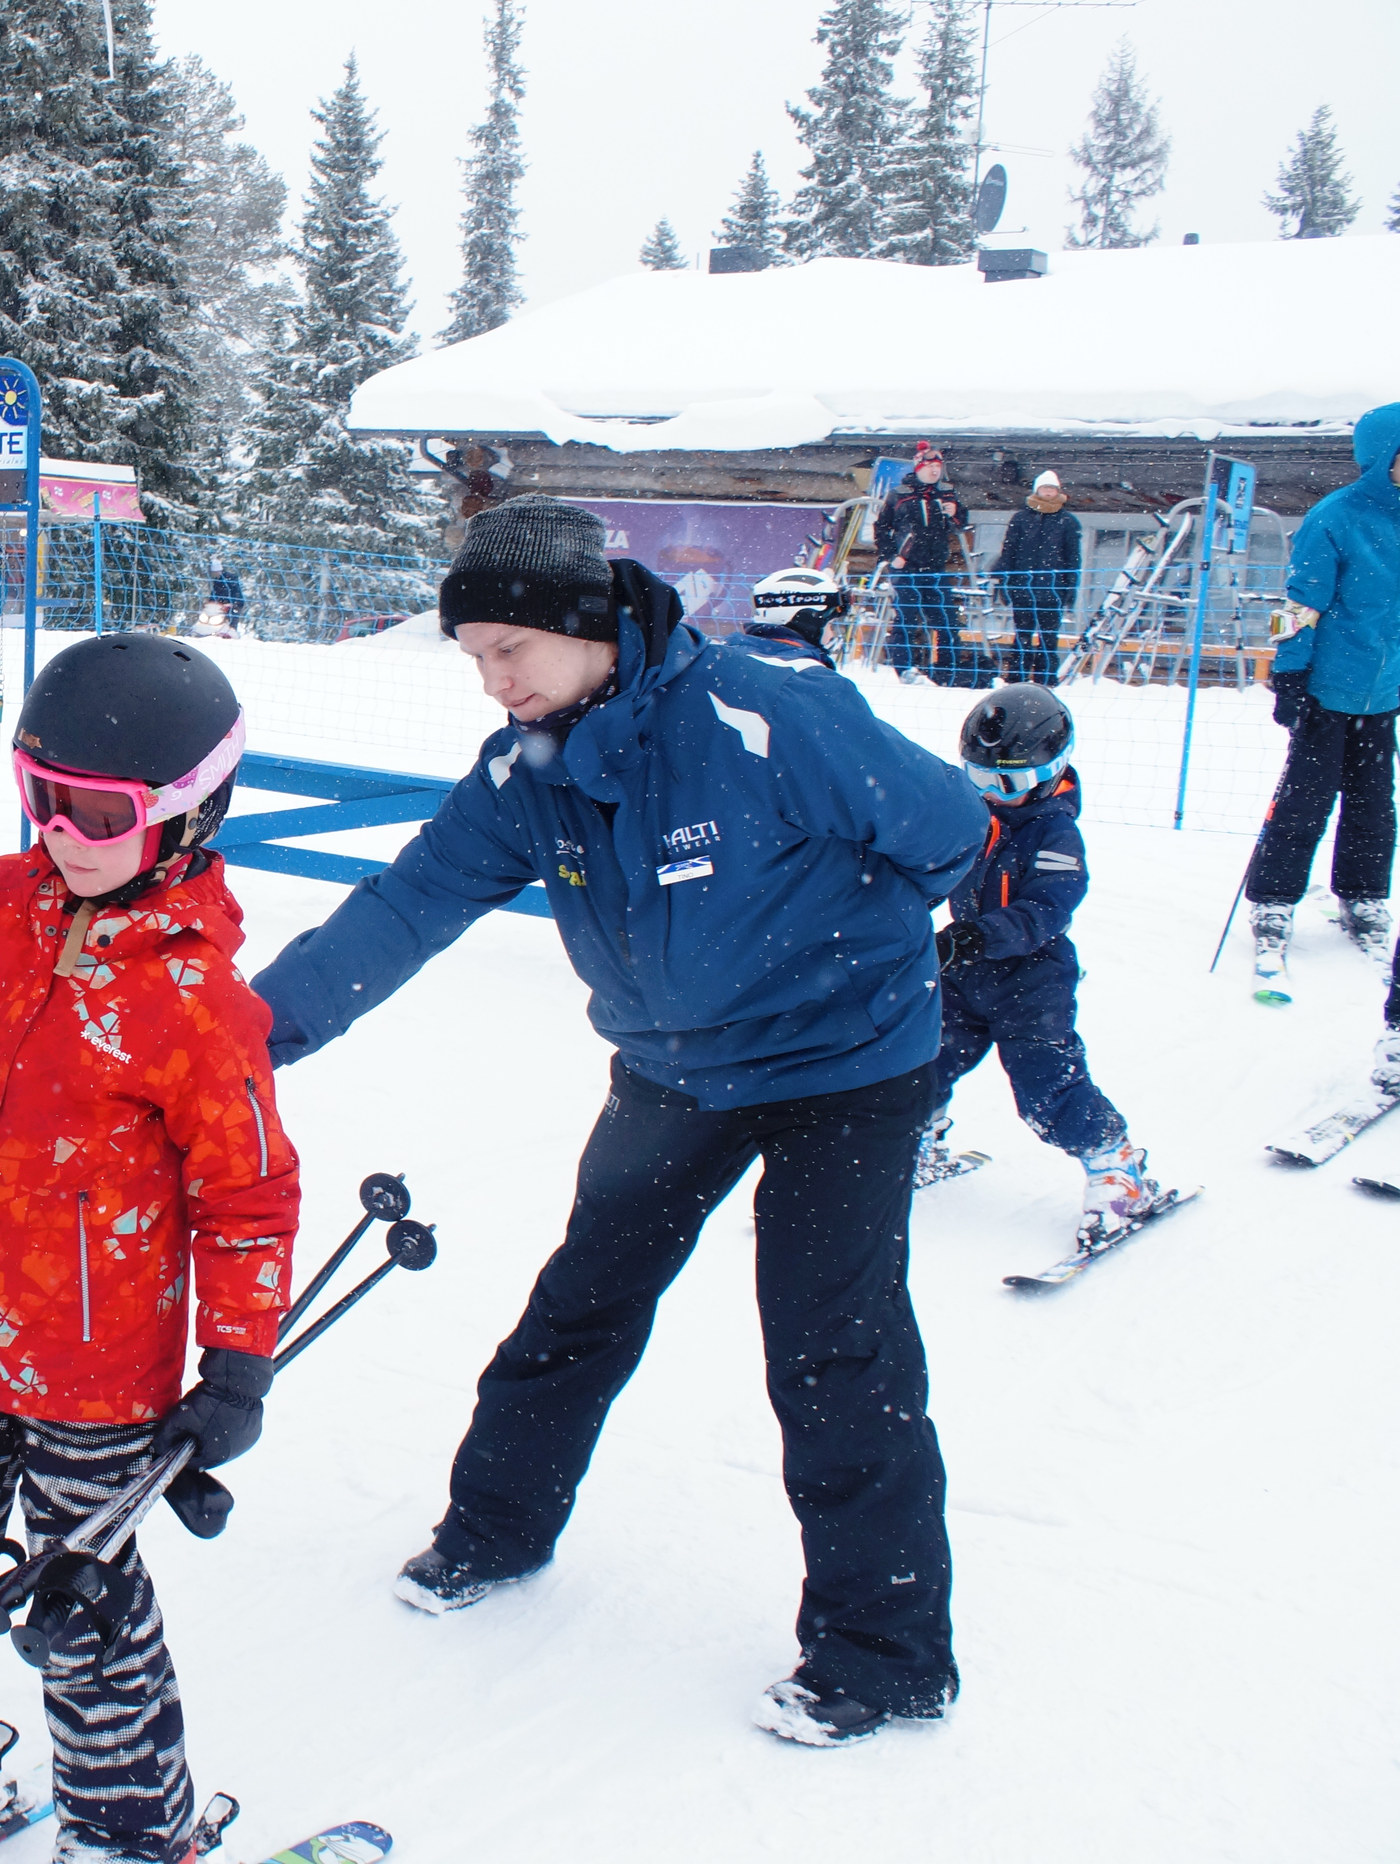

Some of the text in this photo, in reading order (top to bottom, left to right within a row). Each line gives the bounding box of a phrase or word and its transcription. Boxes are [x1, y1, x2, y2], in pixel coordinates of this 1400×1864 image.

[199, 735, 240, 791] SMITH
[90, 1036, 132, 1064] everest
[216, 1324, 233, 1334] TCS
